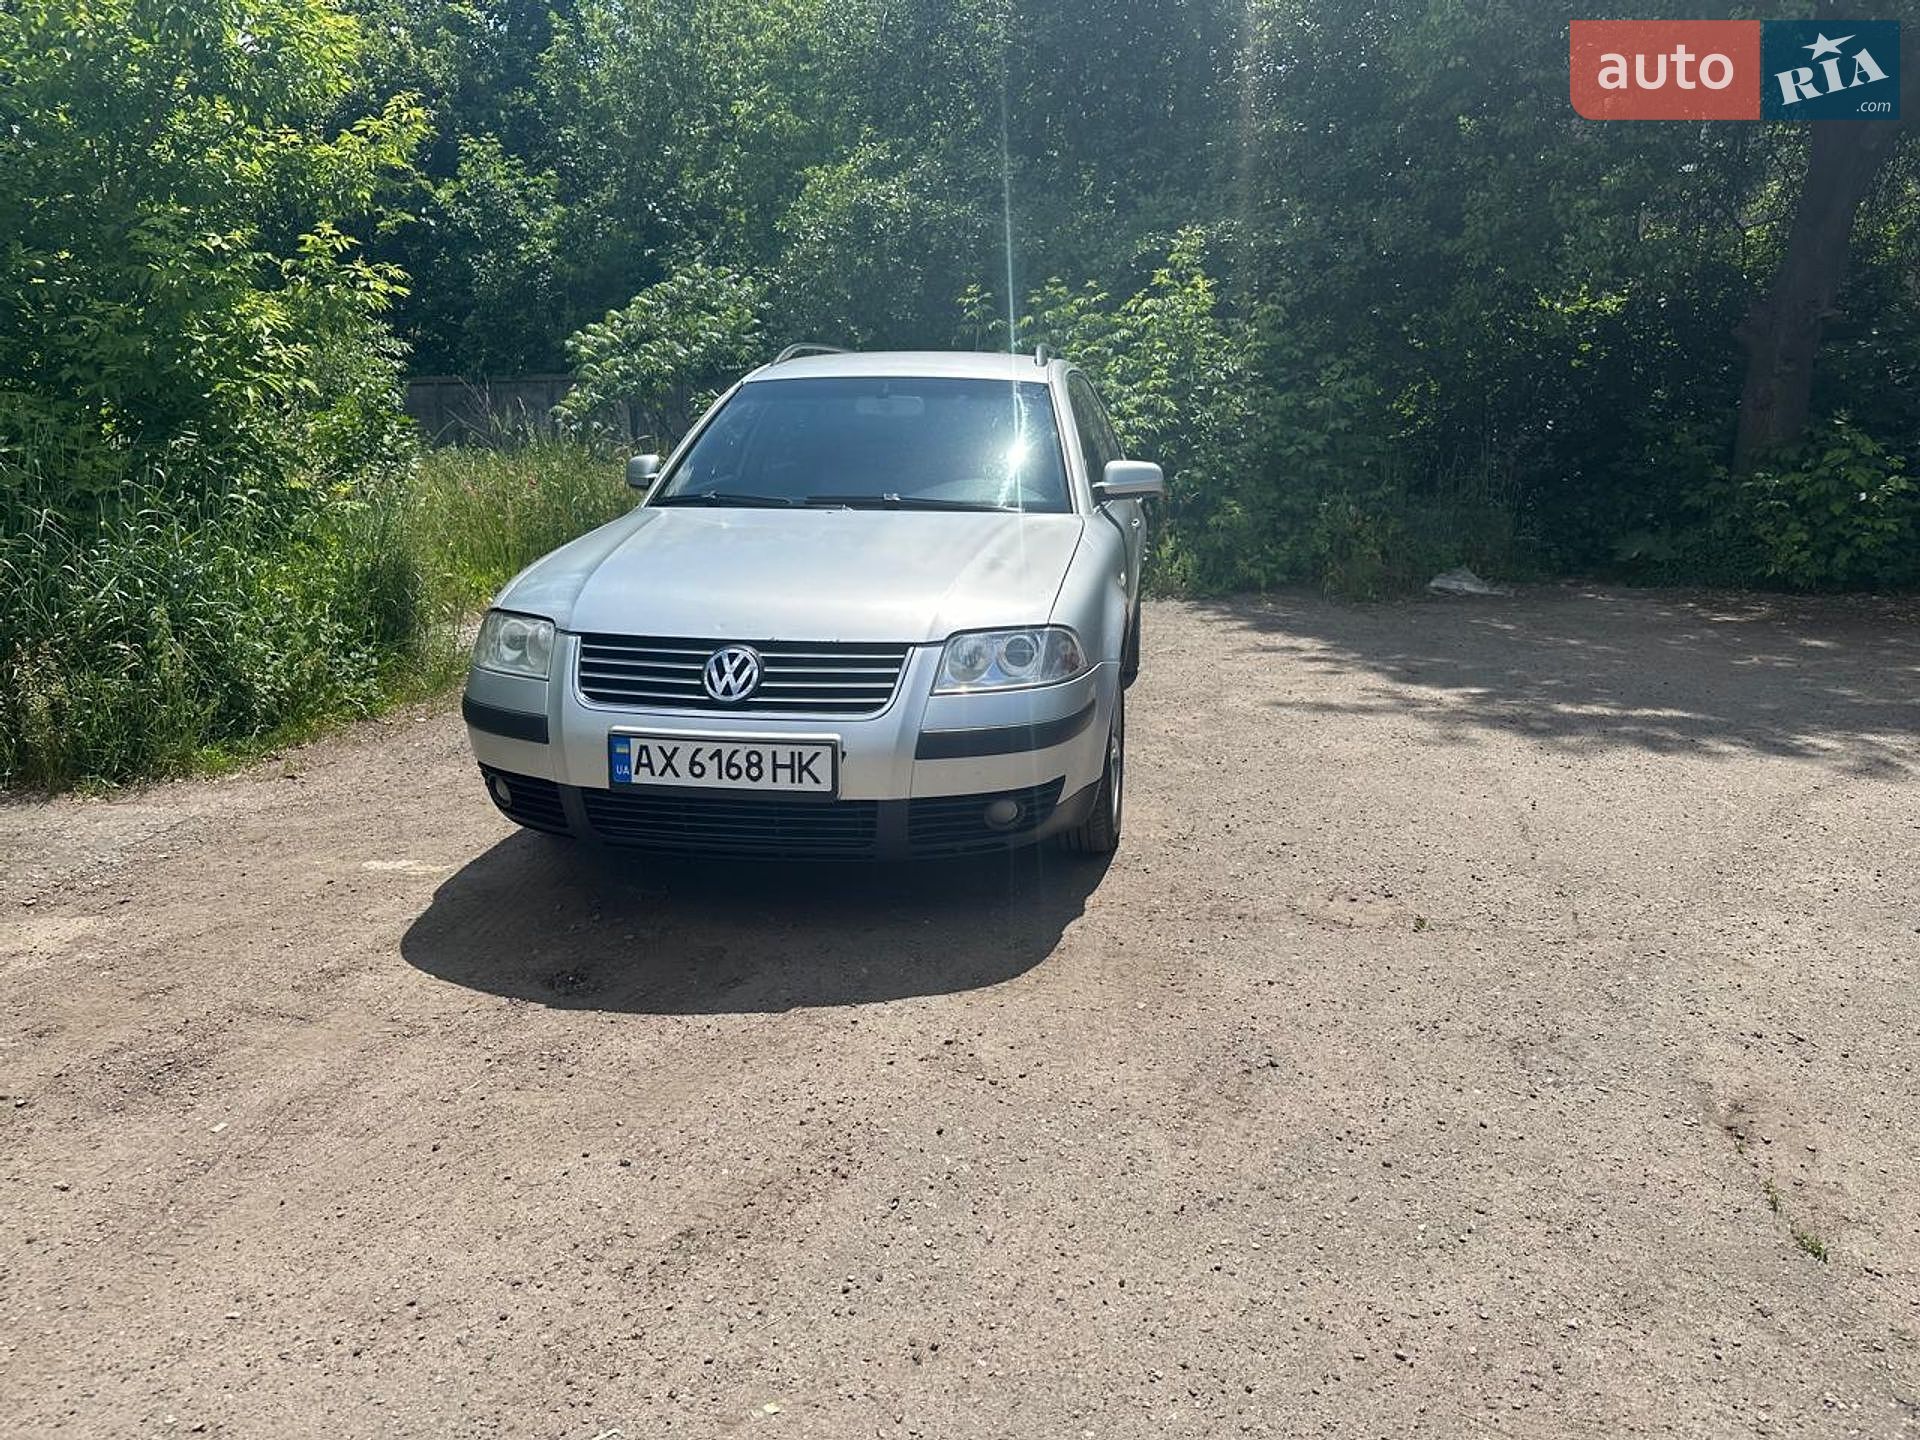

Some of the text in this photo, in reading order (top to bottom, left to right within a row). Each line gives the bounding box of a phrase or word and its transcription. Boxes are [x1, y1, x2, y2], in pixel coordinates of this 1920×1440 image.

[704, 649, 759, 701] VW
[616, 764, 630, 776] UA
[633, 744, 822, 785] AX 6168 HK
